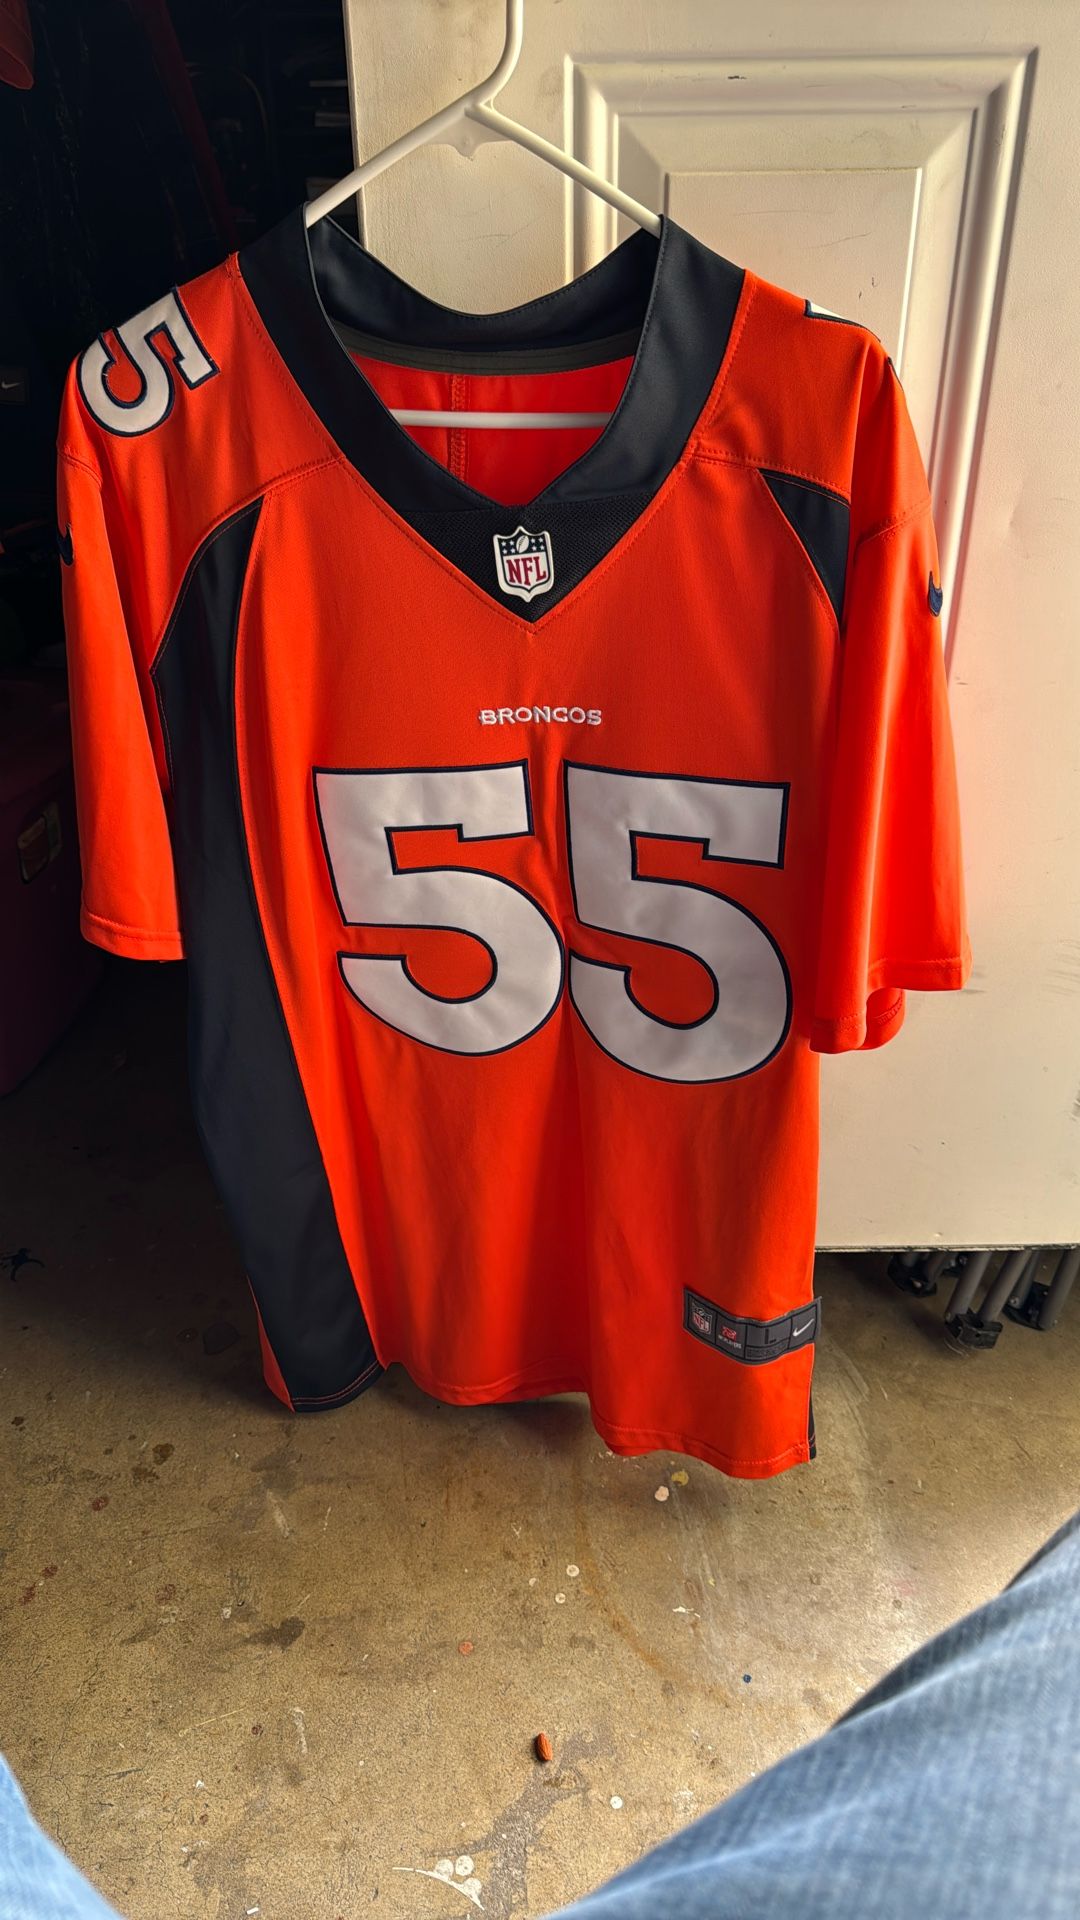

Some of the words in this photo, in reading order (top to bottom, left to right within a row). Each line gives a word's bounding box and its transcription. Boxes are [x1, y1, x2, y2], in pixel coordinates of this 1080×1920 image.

[76, 285, 220, 437] 5
[506, 556, 547, 586] NFL
[479, 706, 602, 725] BRONCOS
[312, 759, 793, 1084] 55
[764, 1328, 777, 1344] L
